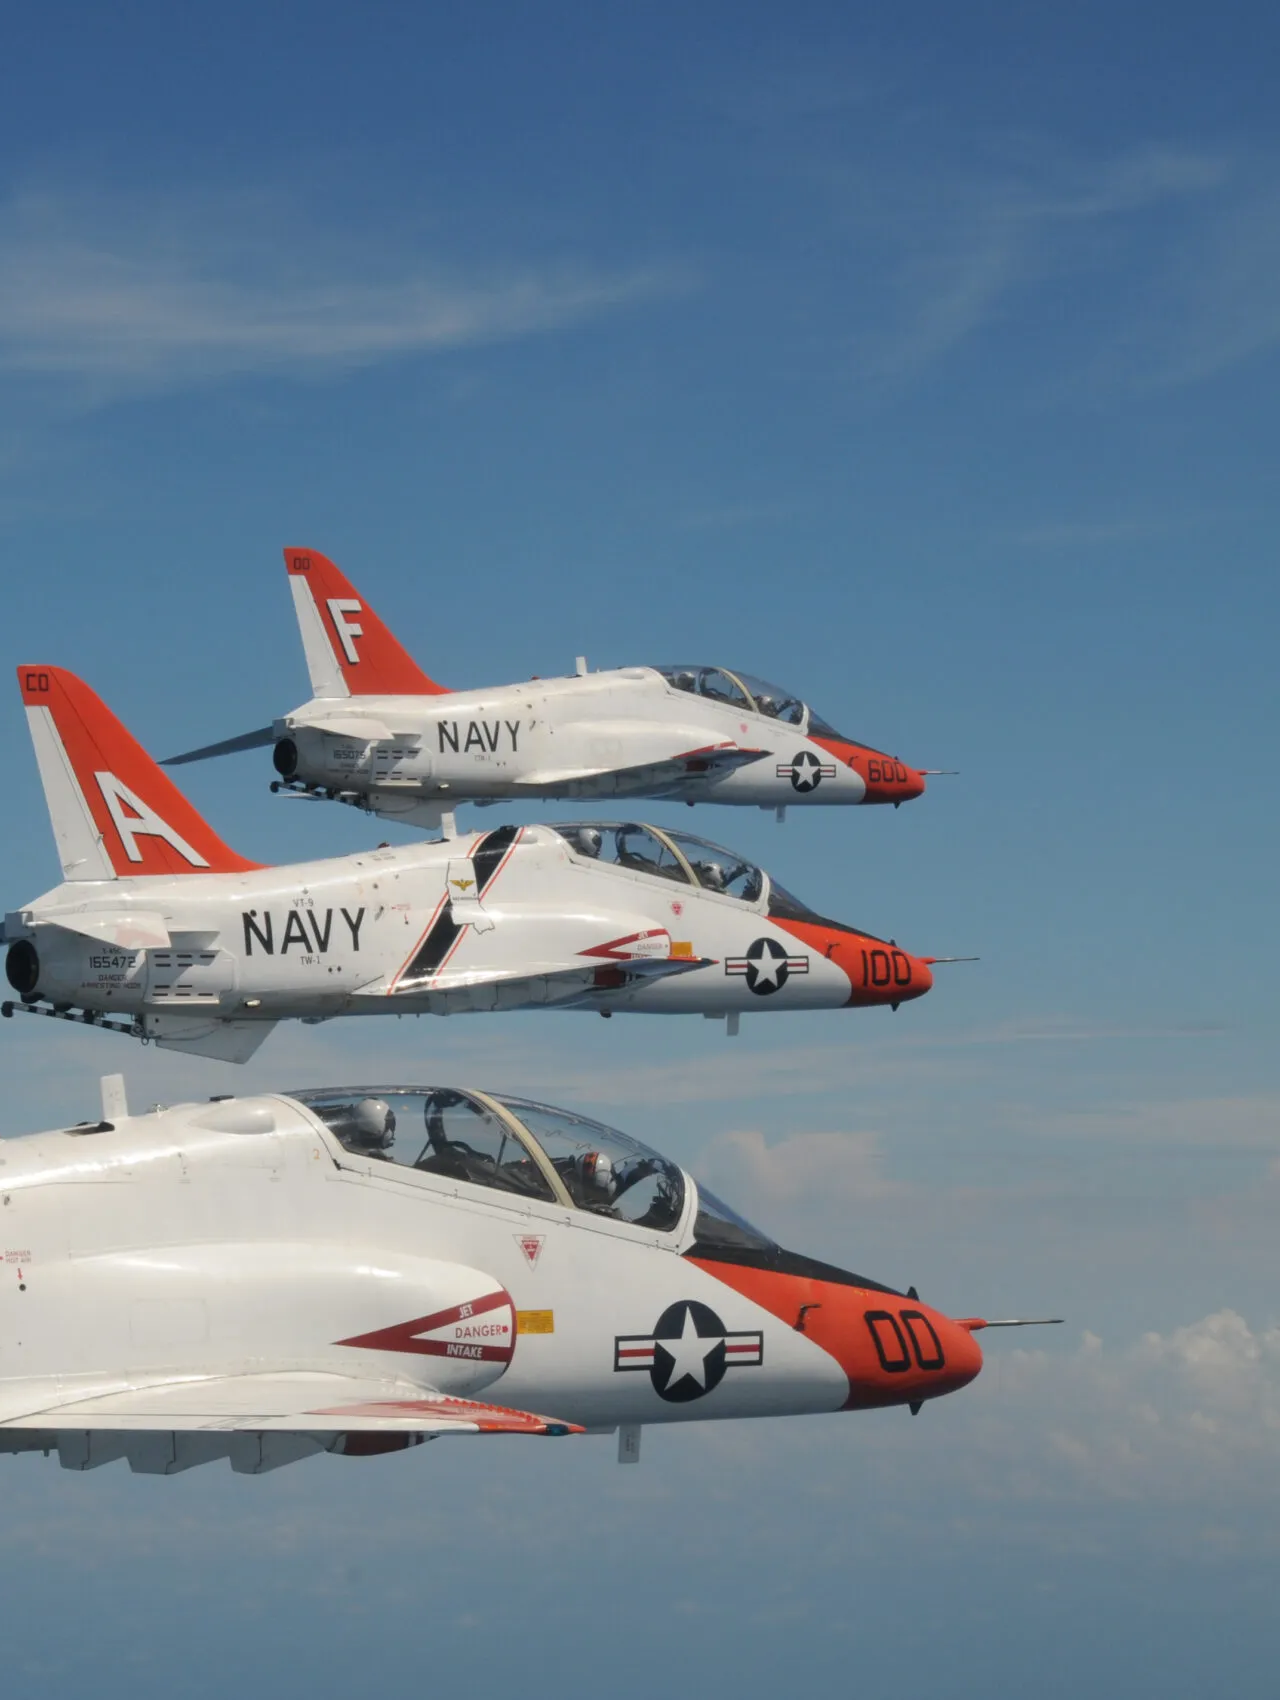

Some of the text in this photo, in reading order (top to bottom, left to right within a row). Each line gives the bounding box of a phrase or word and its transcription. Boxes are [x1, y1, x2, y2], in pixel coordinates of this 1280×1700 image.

[326, 598, 364, 665] F
[26, 673, 49, 692] CO
[437, 719, 520, 753] NAVY
[868, 760, 908, 783] 600
[94, 771, 211, 868] A
[293, 899, 314, 908] VT-9
[242, 907, 366, 957] NAVY
[89, 956, 137, 969] 165472
[300, 956, 321, 965] TW-1
[862, 949, 912, 987] 100
[459, 1304, 474, 1318] JET
[455, 1325, 502, 1339] DANGER
[863, 1310, 945, 1373] 00
[446, 1344, 483, 1358] INTAKE
